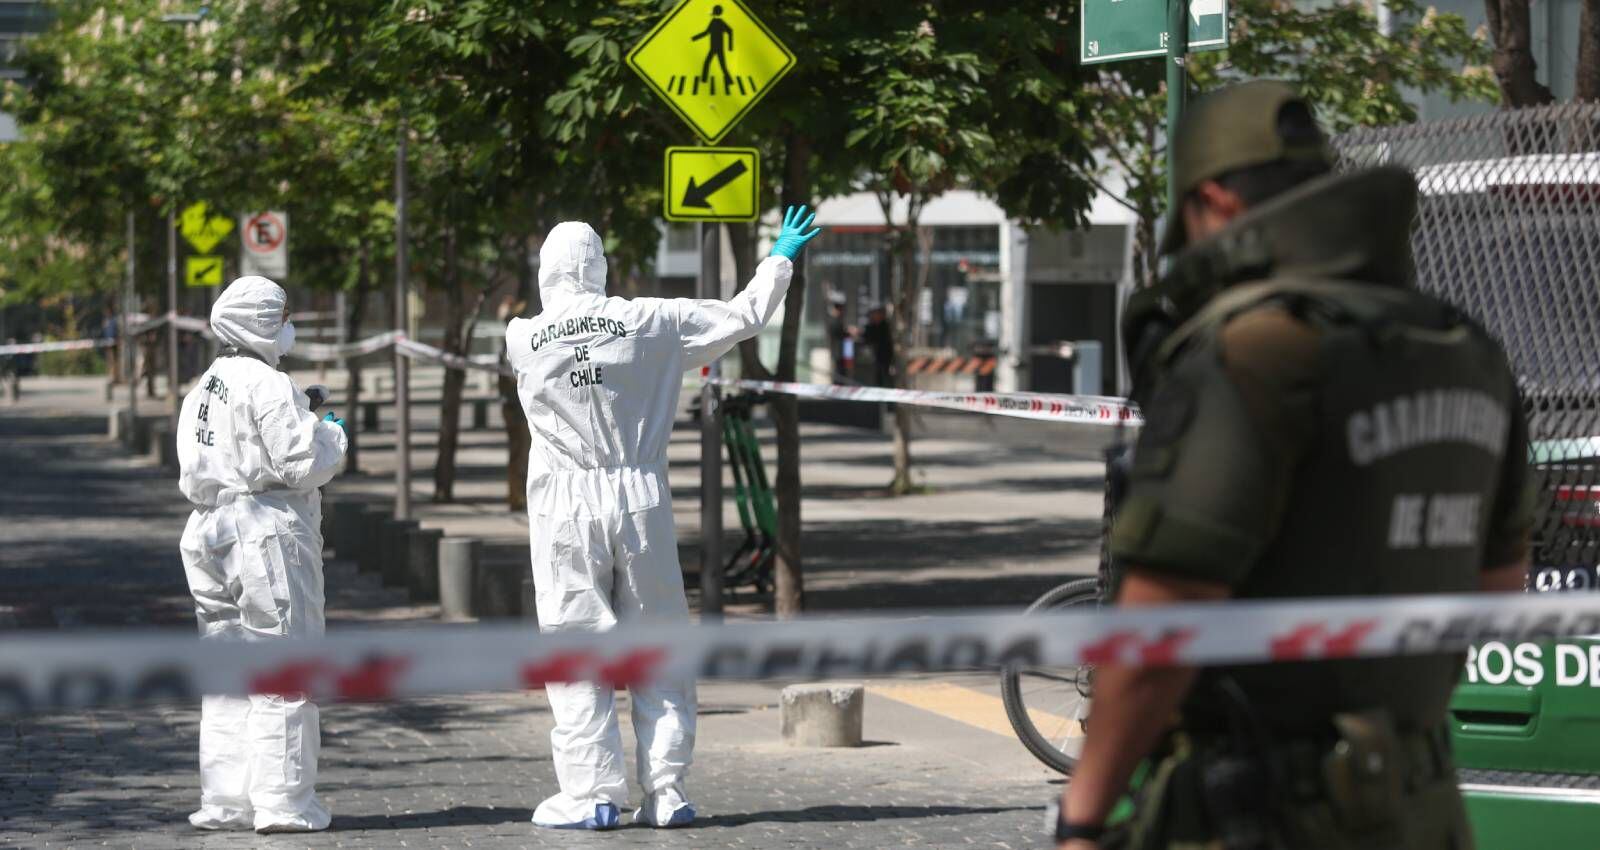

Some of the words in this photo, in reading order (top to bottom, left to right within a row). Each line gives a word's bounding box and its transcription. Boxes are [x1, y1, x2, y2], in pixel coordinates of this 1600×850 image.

[531, 316, 627, 352] CARABINEROS
[574, 344, 591, 362] DE
[570, 367, 603, 388] CHILE
